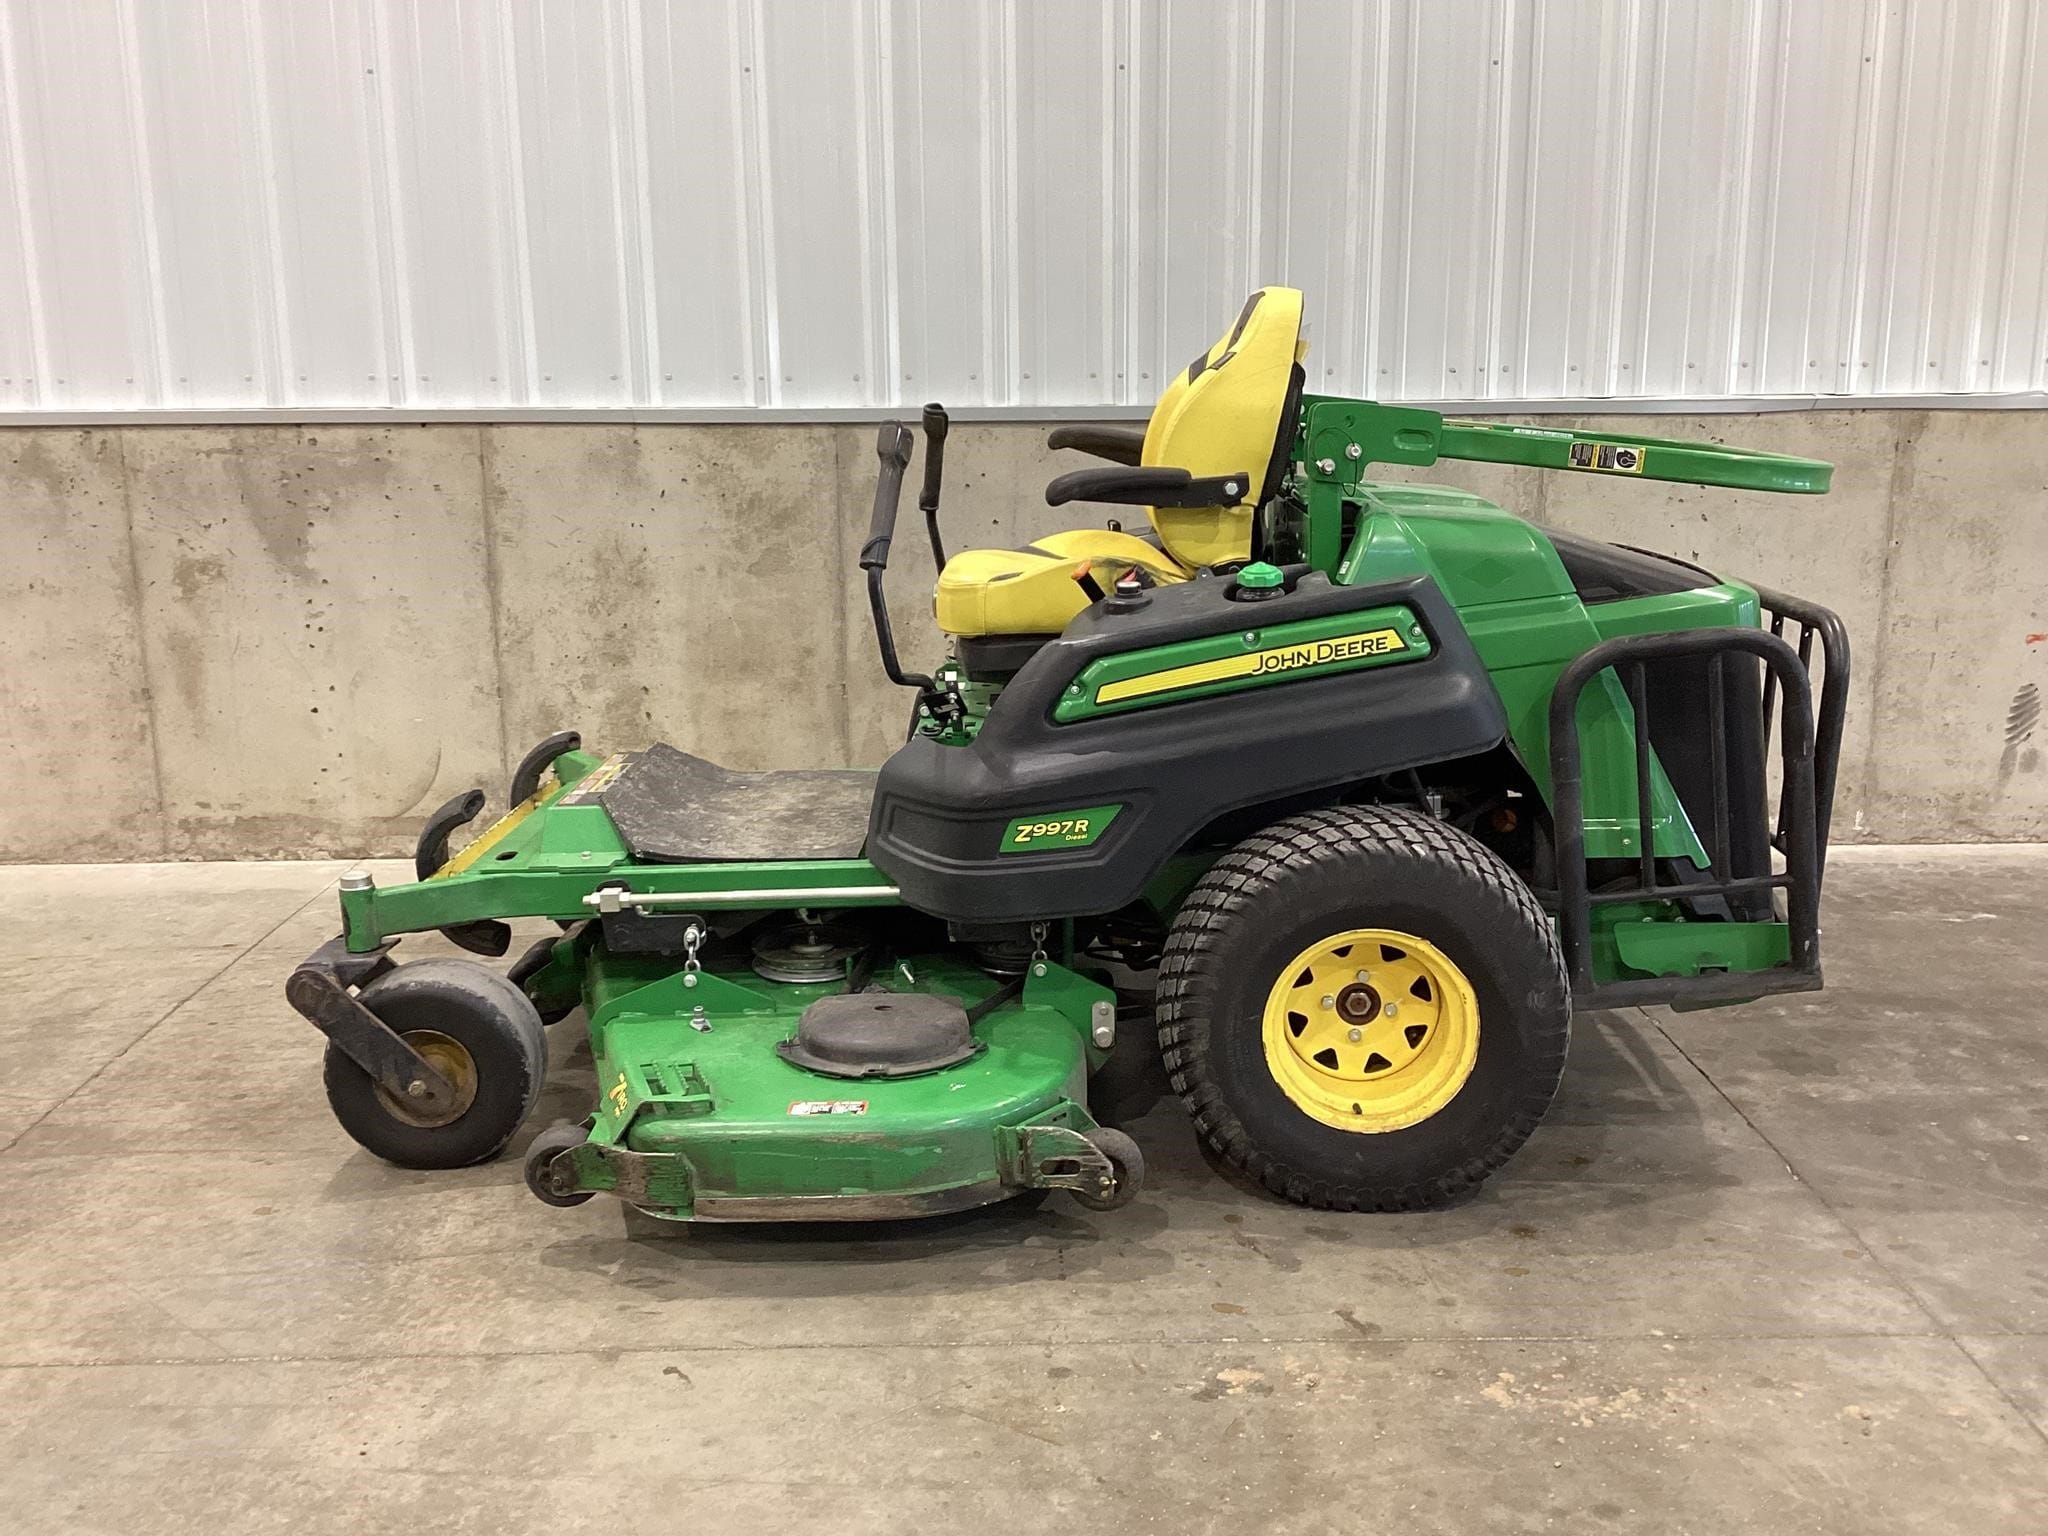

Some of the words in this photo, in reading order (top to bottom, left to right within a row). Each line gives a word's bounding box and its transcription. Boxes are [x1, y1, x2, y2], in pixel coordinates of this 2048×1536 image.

[1252, 648, 1312, 673] JOHN
[1316, 636, 1388, 661] DEERE
[1014, 820, 1089, 842] Z997R
